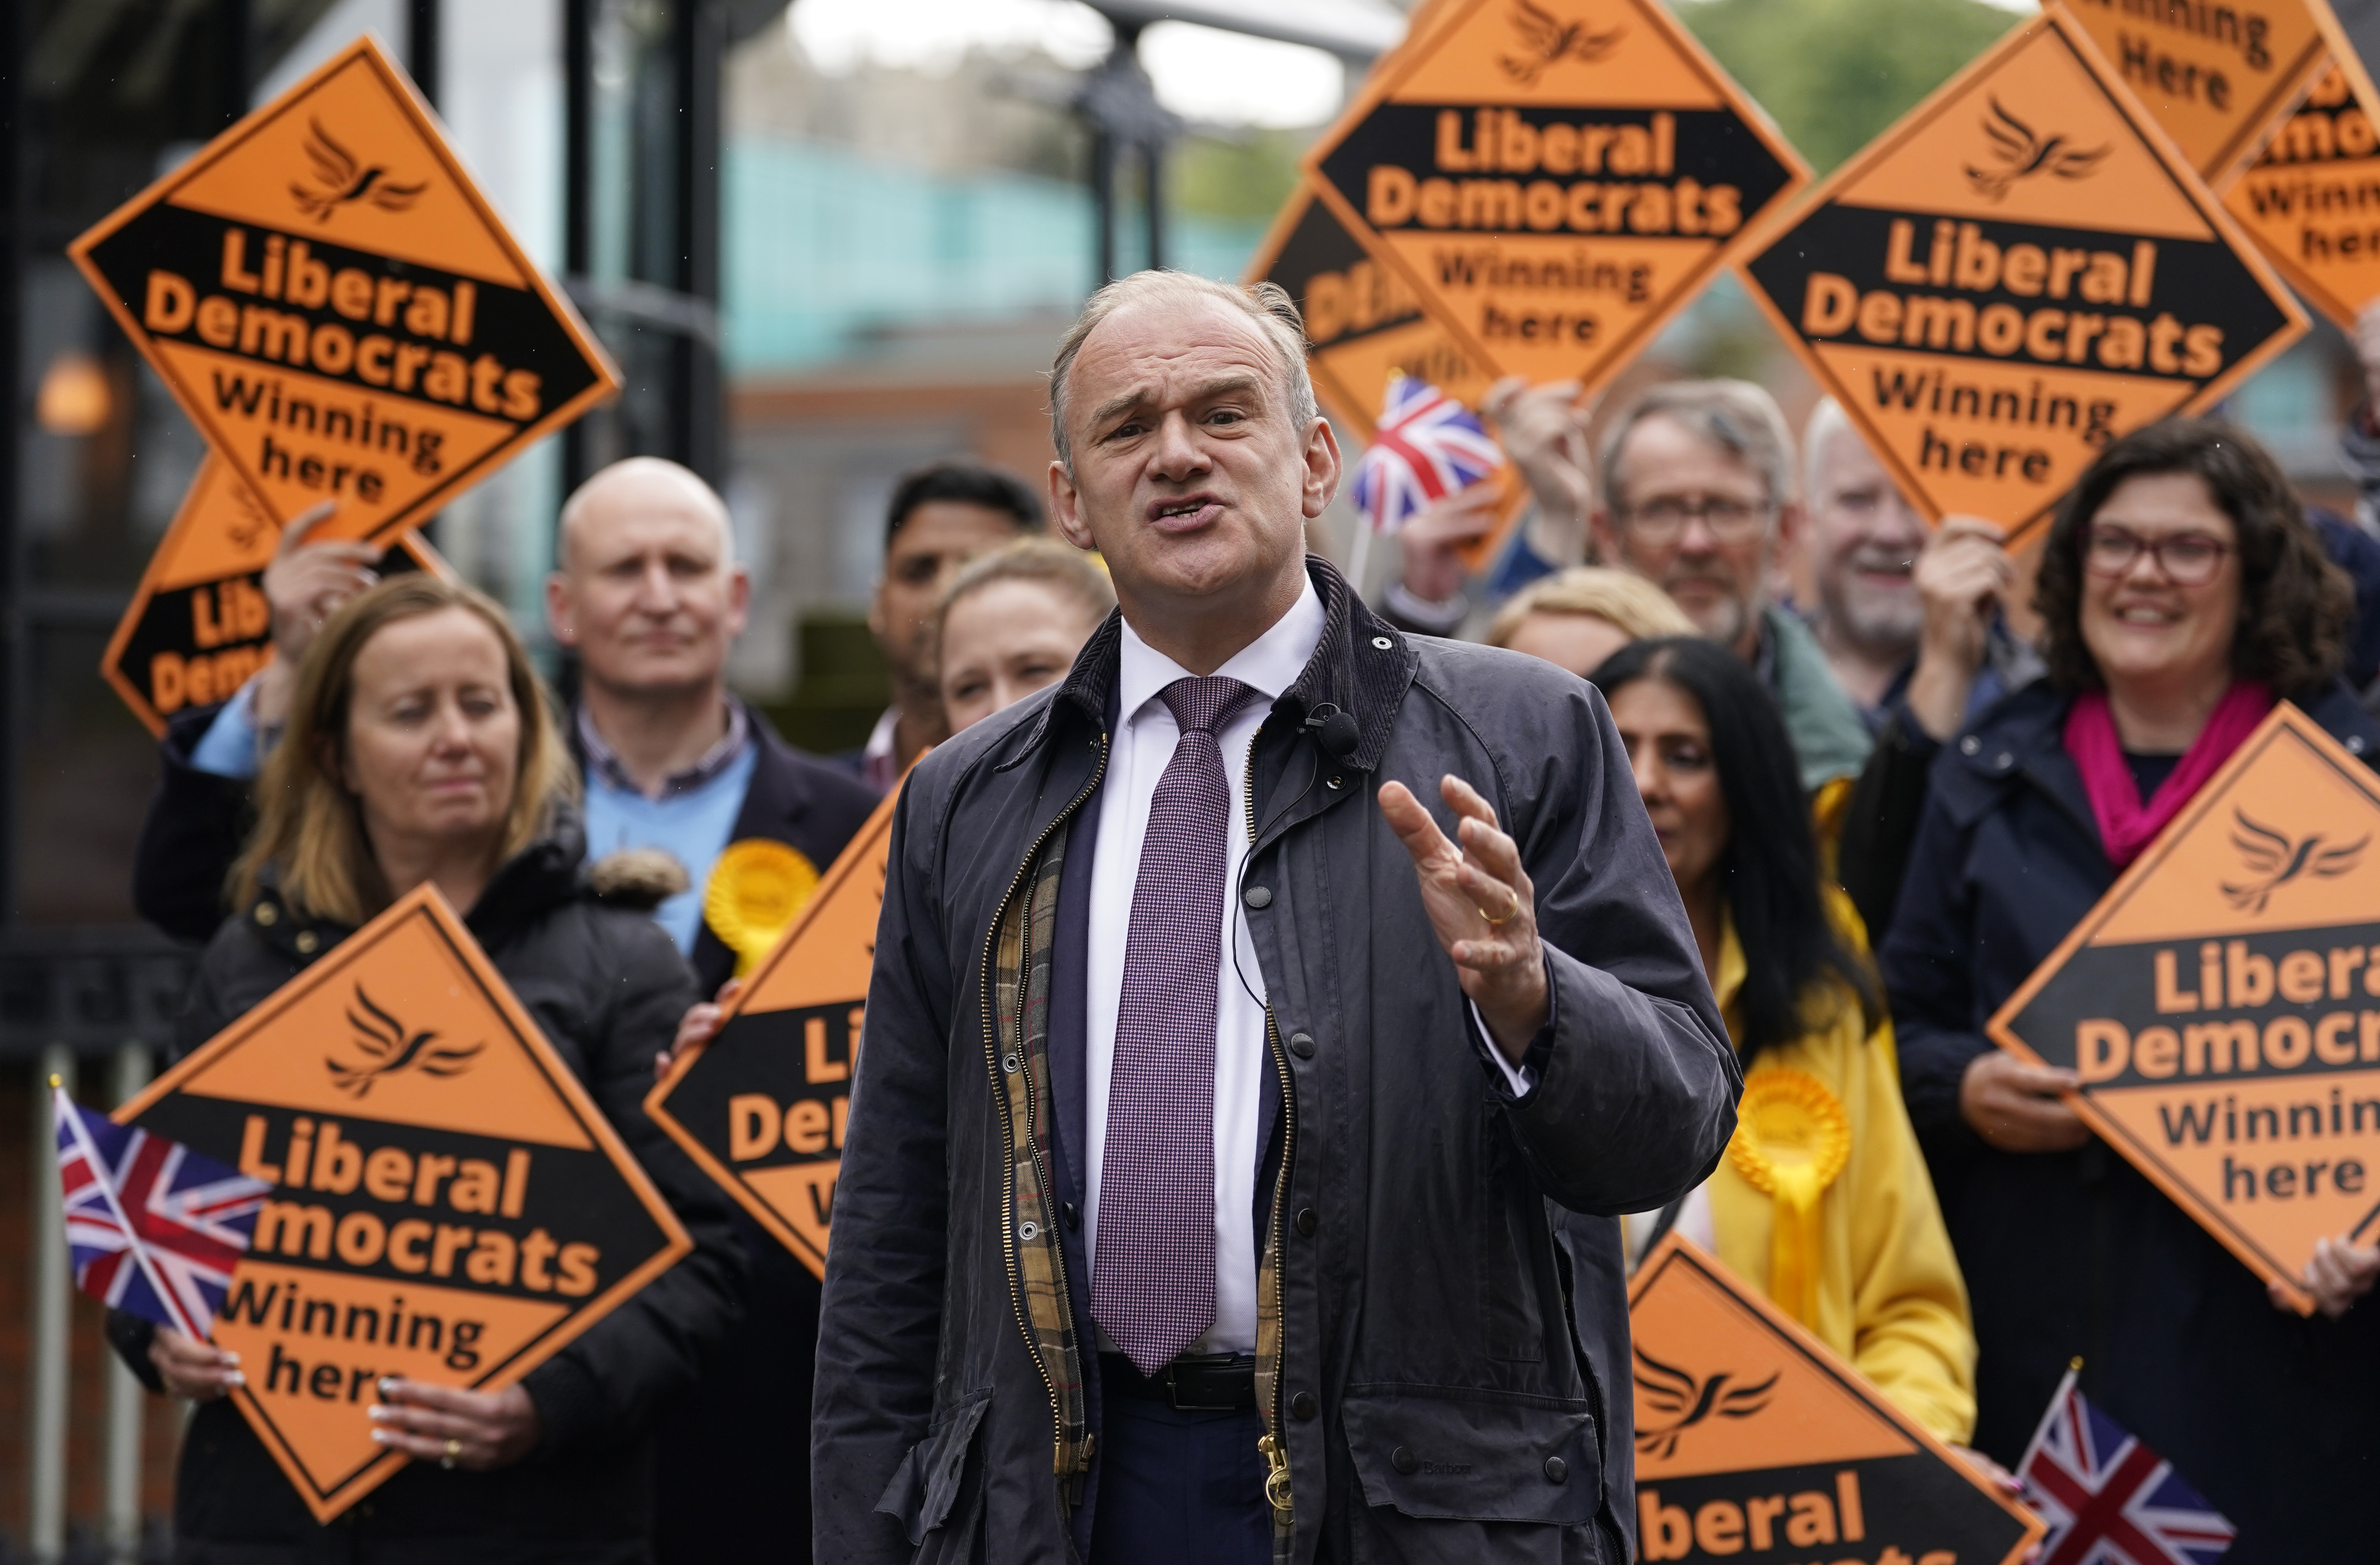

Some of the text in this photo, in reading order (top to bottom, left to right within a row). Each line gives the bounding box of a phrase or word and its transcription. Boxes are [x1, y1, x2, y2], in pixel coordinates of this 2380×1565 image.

[2118, 28, 2231, 114] Here
[1435, 109, 1676, 177] Liberal
[1366, 164, 1742, 236] Democrats
[221, 228, 477, 345] Liberal
[1434, 247, 1651, 305] Winning
[1885, 219, 2157, 307] Liberal
[144, 269, 542, 418] Democrats
[1483, 302, 1595, 342] here
[1802, 272, 2224, 377] Democrats
[213, 369, 443, 475] Winning
[1871, 363, 2115, 447] Winning
[262, 436, 384, 503] here
[1919, 425, 2052, 482] here
[2154, 940, 2380, 1014] Liber
[2075, 1010, 2380, 1084] Democr
[2158, 1086, 2380, 1147] Winnin
[238, 1115, 531, 1219] Liberal
[2223, 1157, 2365, 1202] here
[254, 1197, 600, 1296] mocrats
[221, 1279, 487, 1371] Winning
[1636, 1470, 1865, 1562] beral
